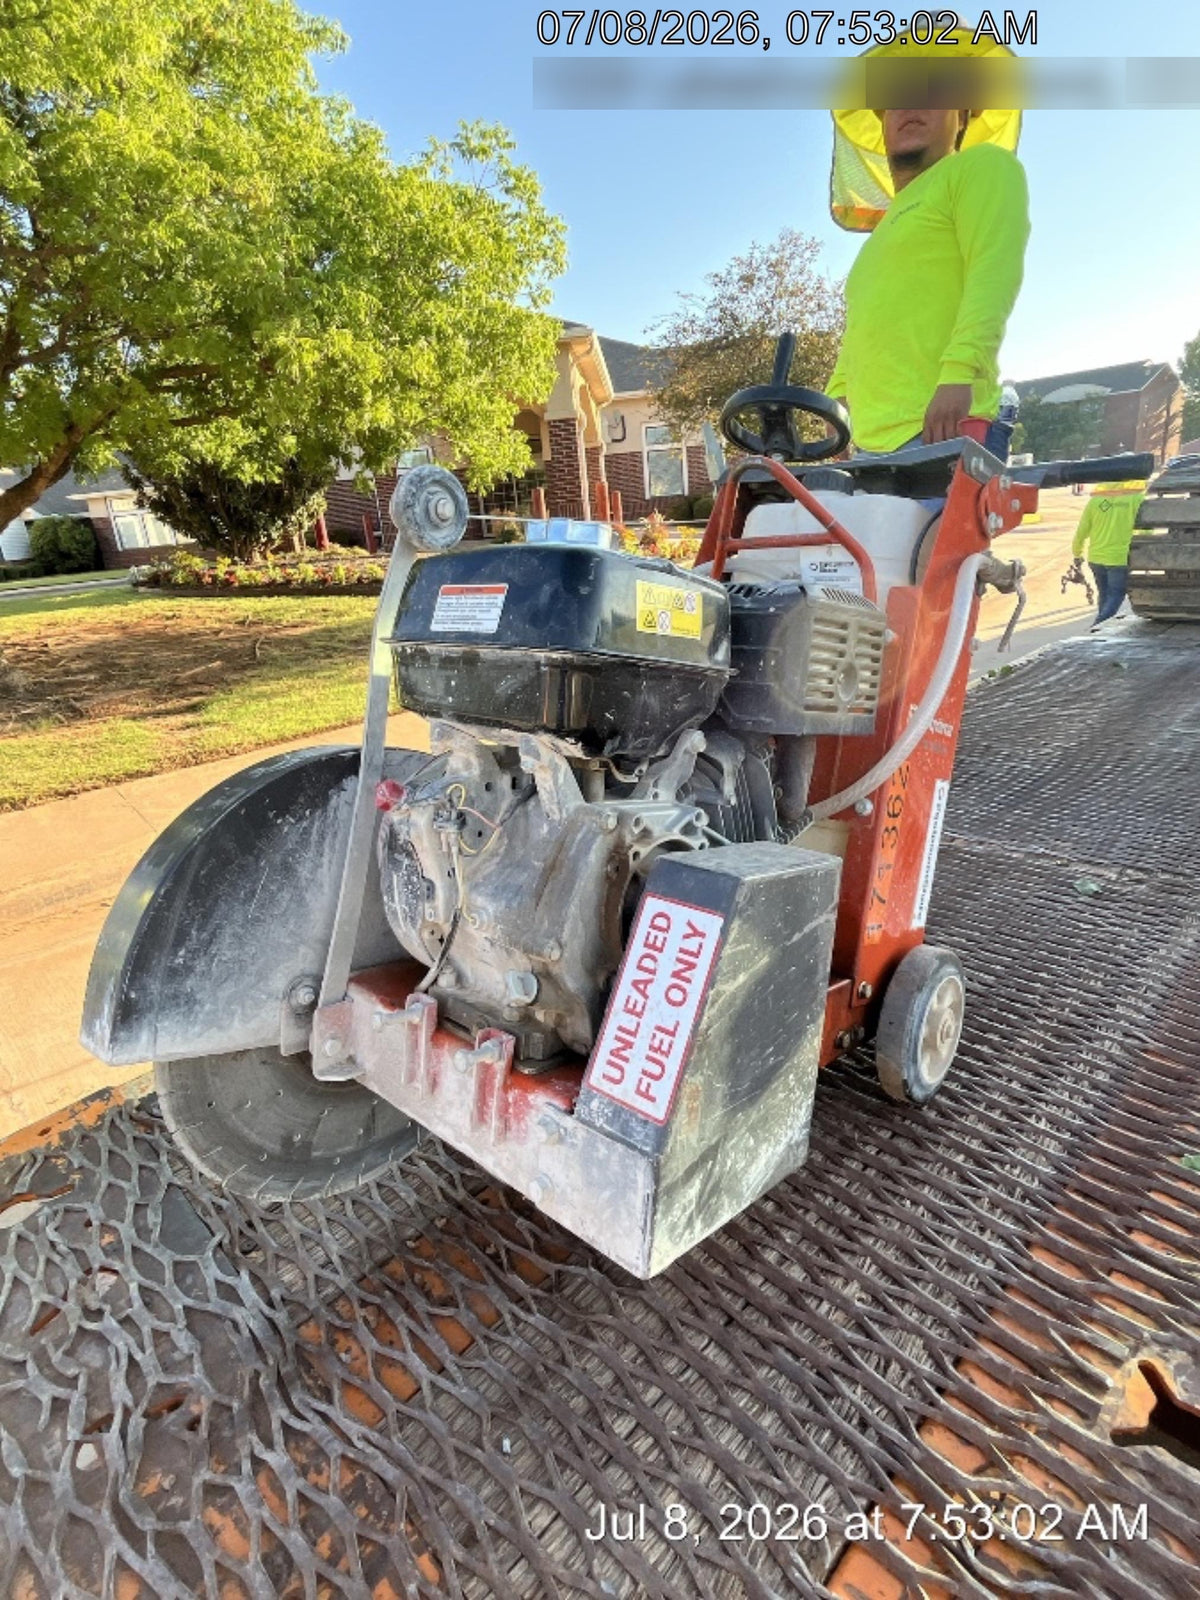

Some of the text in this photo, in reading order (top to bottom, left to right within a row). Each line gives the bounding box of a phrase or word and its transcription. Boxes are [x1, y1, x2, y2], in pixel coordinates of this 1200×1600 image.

[602, 911, 673, 1086] UNLEADED
[634, 919, 707, 1103] FUEL ONLY
